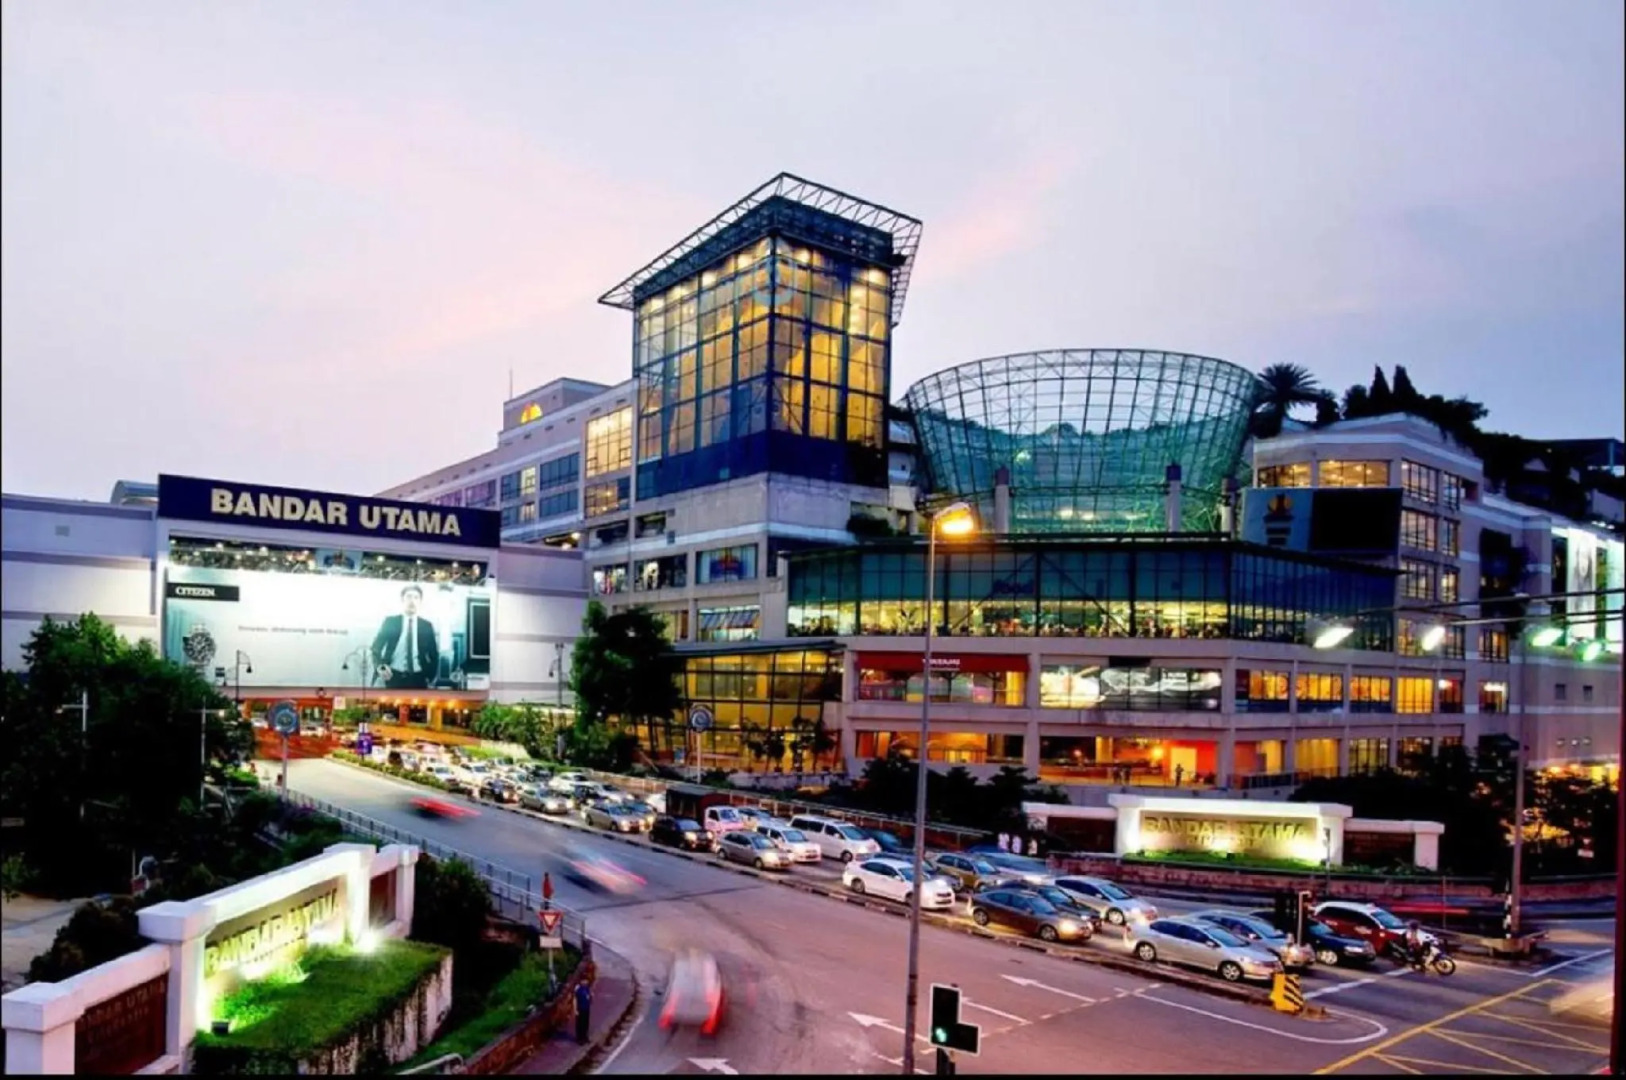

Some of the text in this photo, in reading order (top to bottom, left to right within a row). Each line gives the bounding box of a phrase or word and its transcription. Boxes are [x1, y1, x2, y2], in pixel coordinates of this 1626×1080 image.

[211, 488, 461, 537] BANDAR UTAMA
[175, 586, 216, 597] CITIZEN
